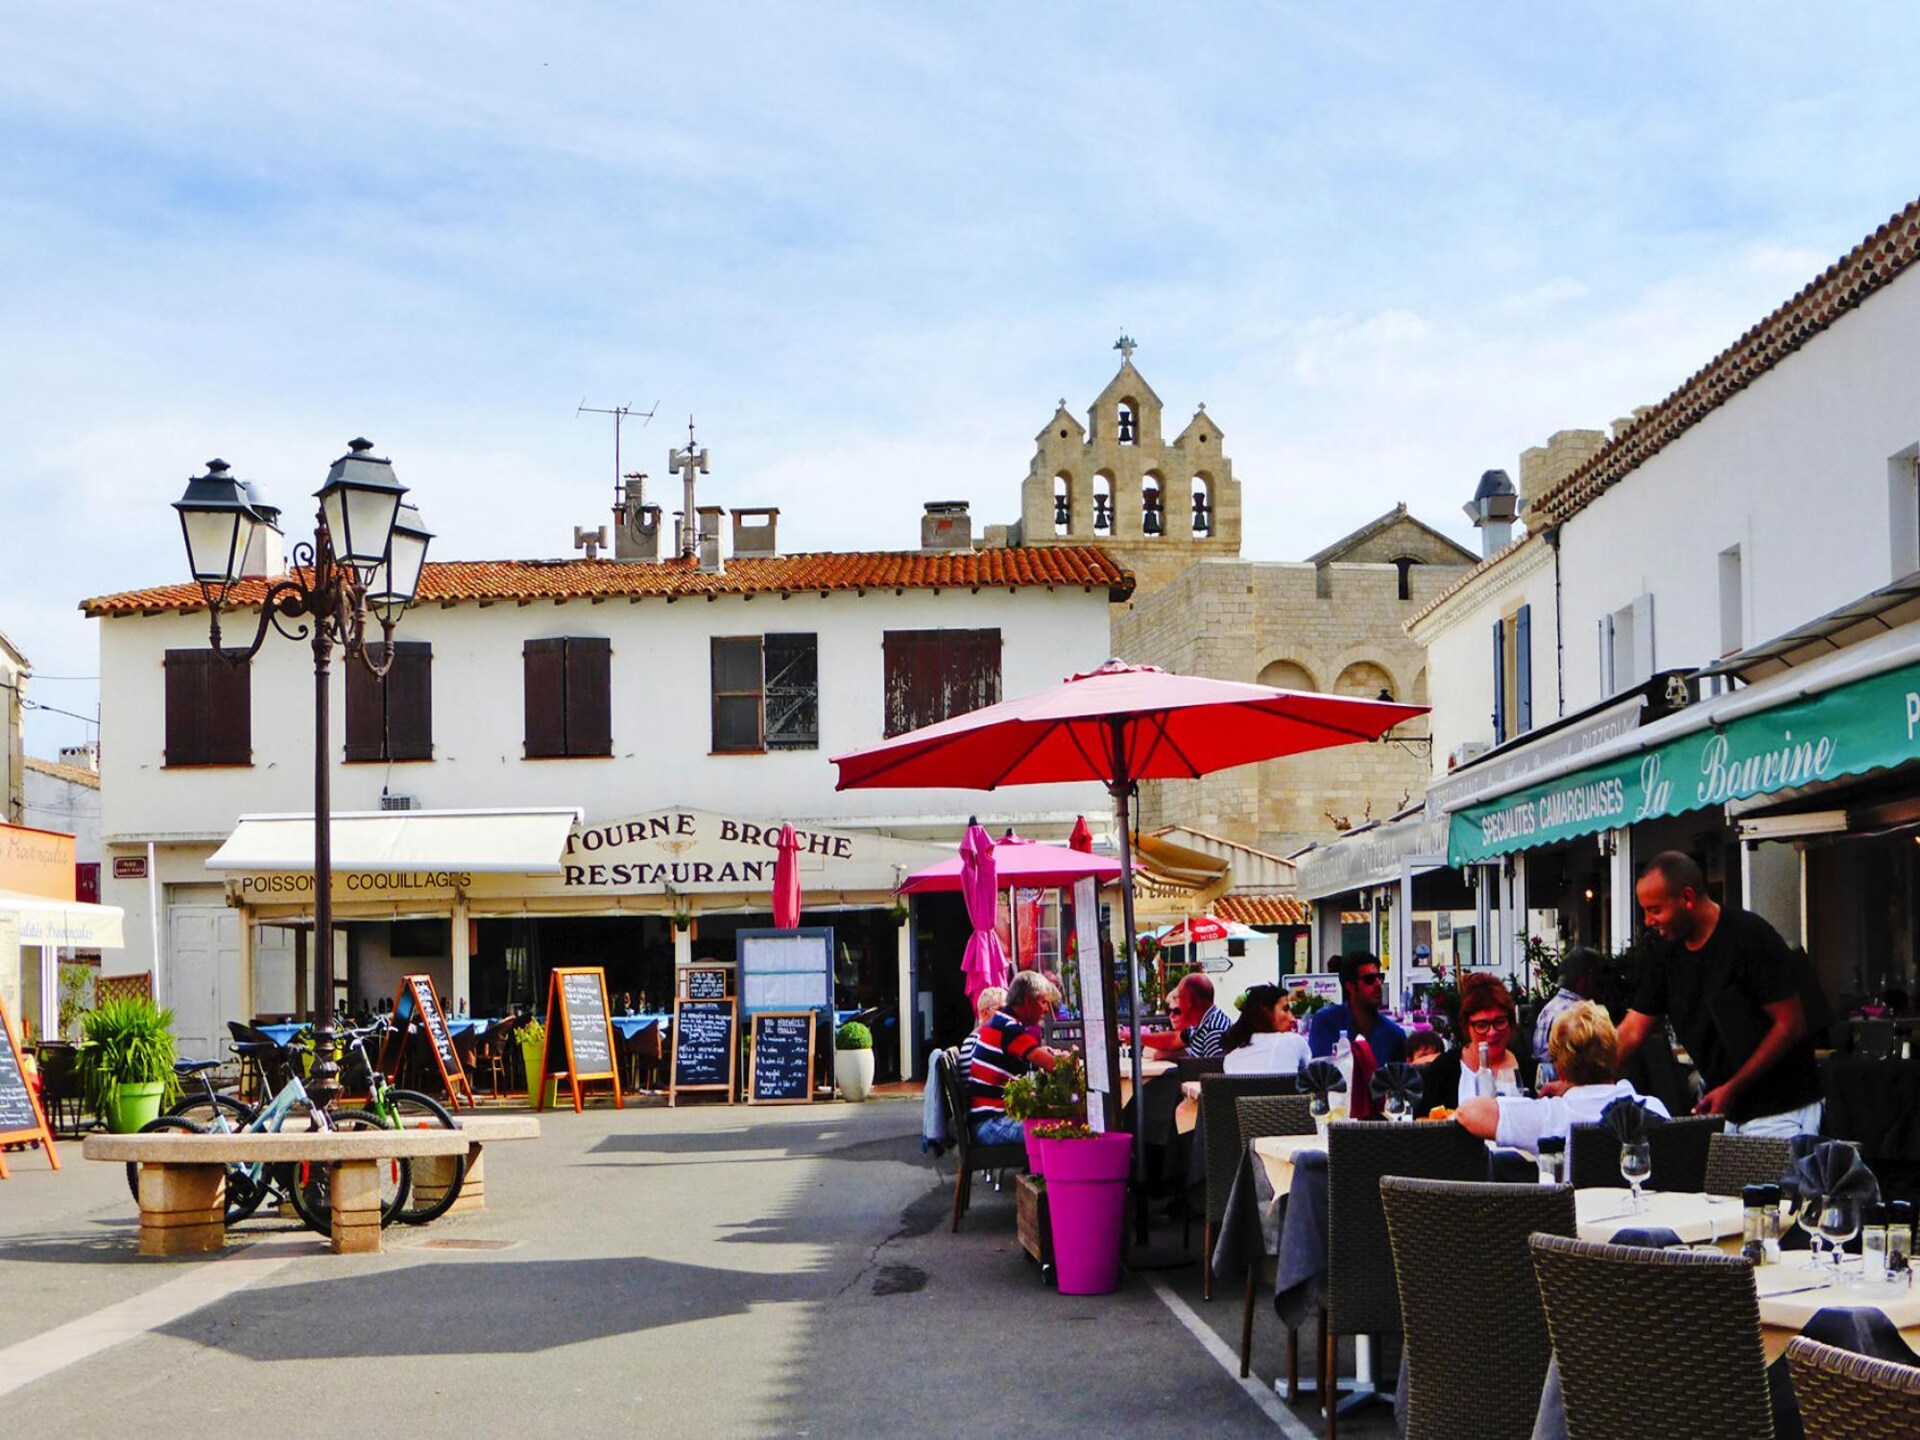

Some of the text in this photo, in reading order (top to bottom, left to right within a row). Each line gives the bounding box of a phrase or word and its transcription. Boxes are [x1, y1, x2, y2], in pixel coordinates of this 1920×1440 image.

[1636, 730, 1838, 819] La Bouvine
[1481, 802, 1535, 846] SPECIALITES
[1539, 777, 1623, 829] CAMARGUAISES
[566, 814, 853, 859] TOURNE BROCHE
[243, 871, 471, 892] POISSON COQUILLAGES
[564, 861, 777, 886] RESTAURANT
